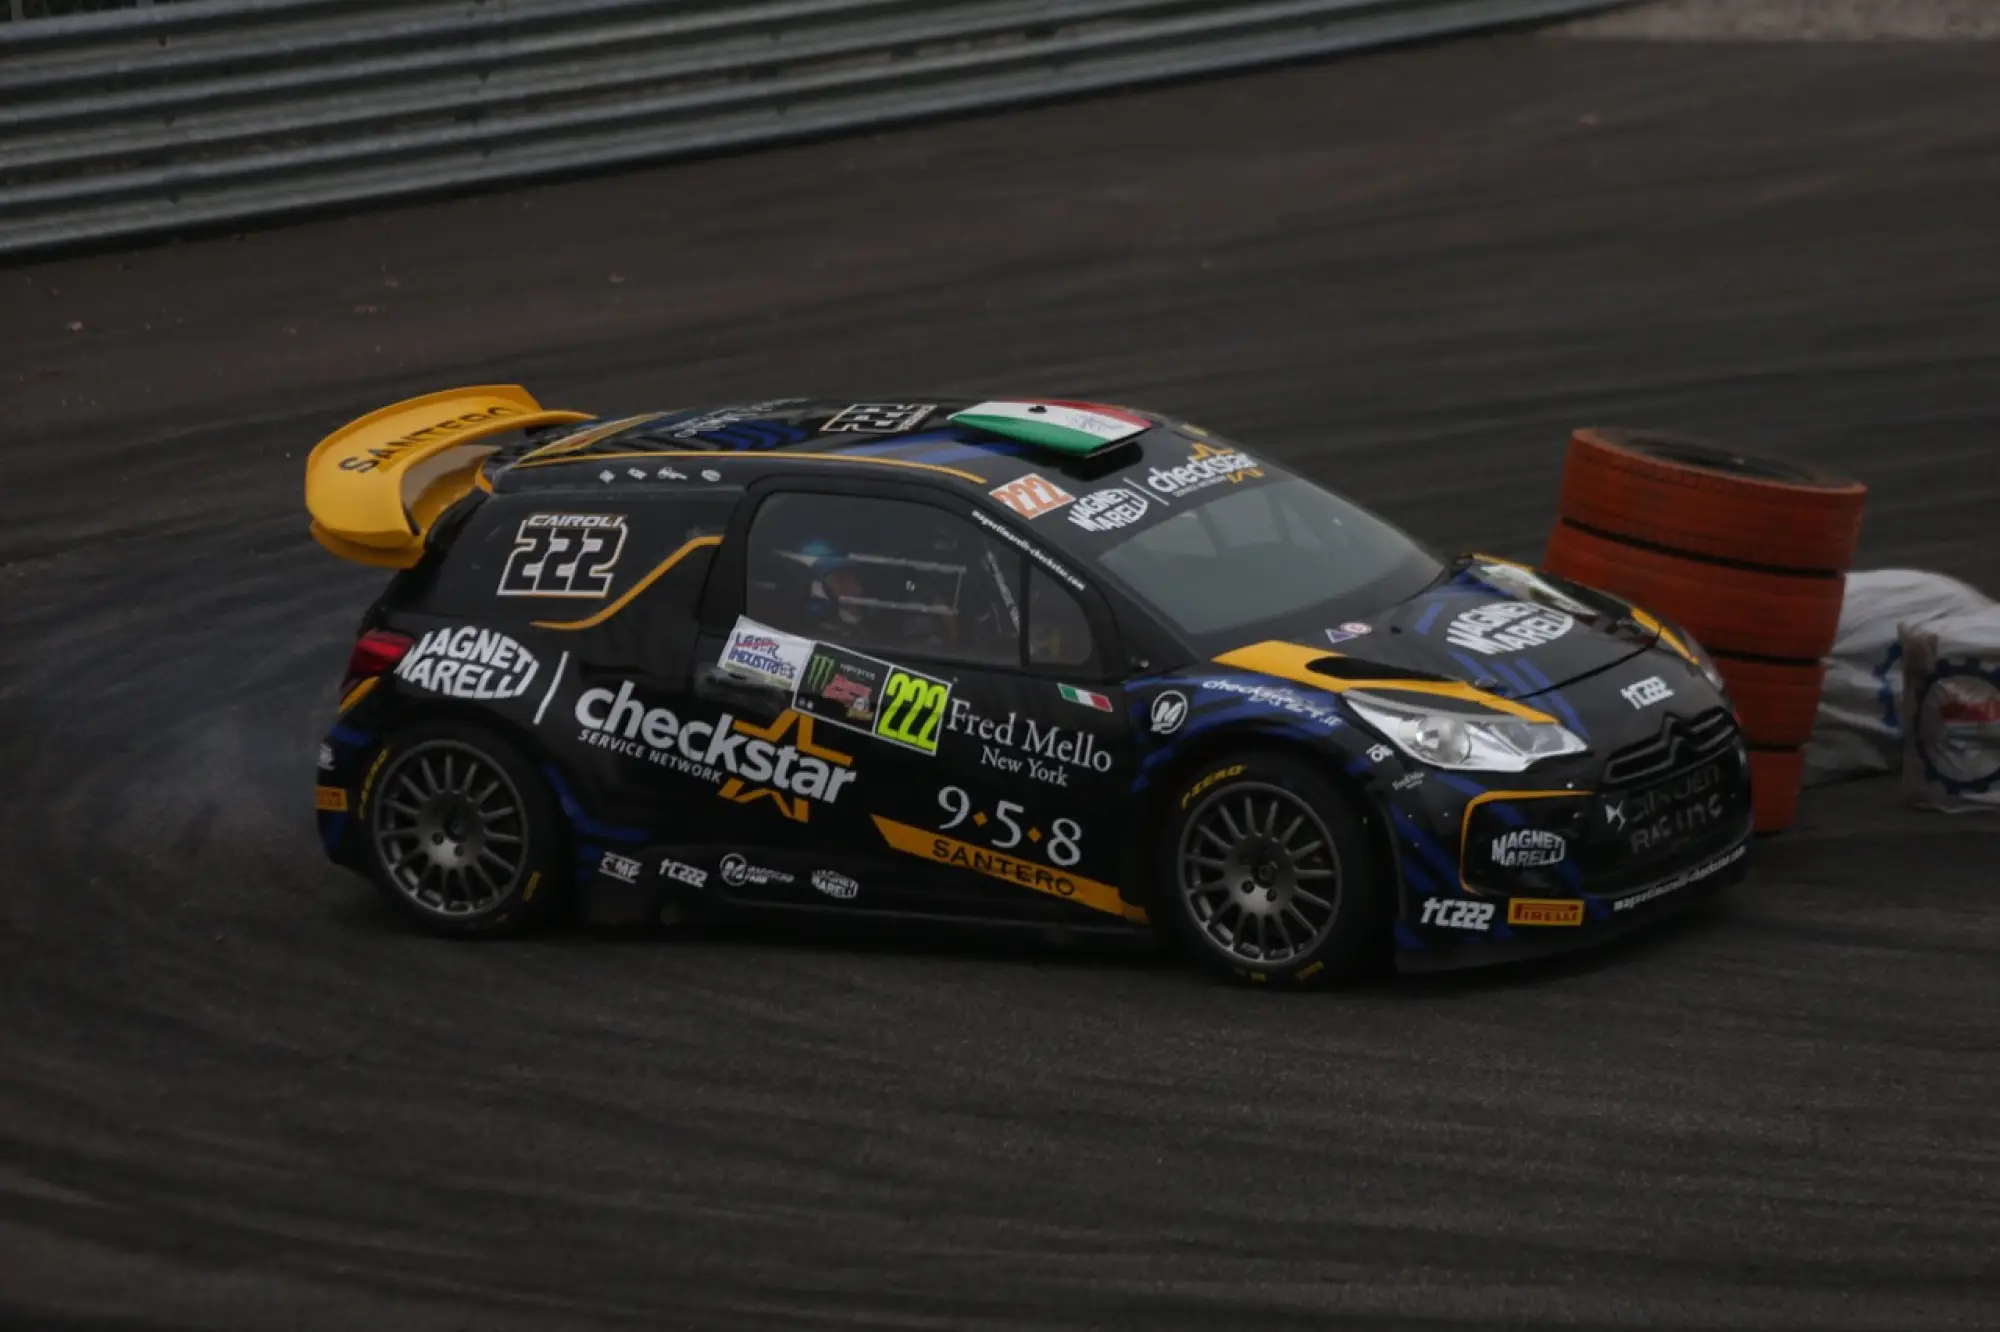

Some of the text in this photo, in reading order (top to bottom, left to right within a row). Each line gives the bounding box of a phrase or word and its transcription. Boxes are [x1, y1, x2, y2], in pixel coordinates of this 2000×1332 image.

[526, 514, 628, 527] CAIROLI
[991, 475, 1076, 519] 222
[496, 520, 629, 597] 222
[396, 625, 540, 676] MAGNETI
[736, 632, 781, 660] LASER
[393, 656, 536, 699] MARELLI
[877, 672, 948, 751] 222
[945, 697, 1114, 773] Fred Mello
[575, 680, 856, 803] checkstar
[577, 729, 724, 784] SERVICE NETWORK
[980, 744, 1070, 788] New York
[1491, 829, 1566, 854] MAGNETI
[1491, 846, 1566, 867] MARELLI
[931, 839, 1076, 896] SANTERO
